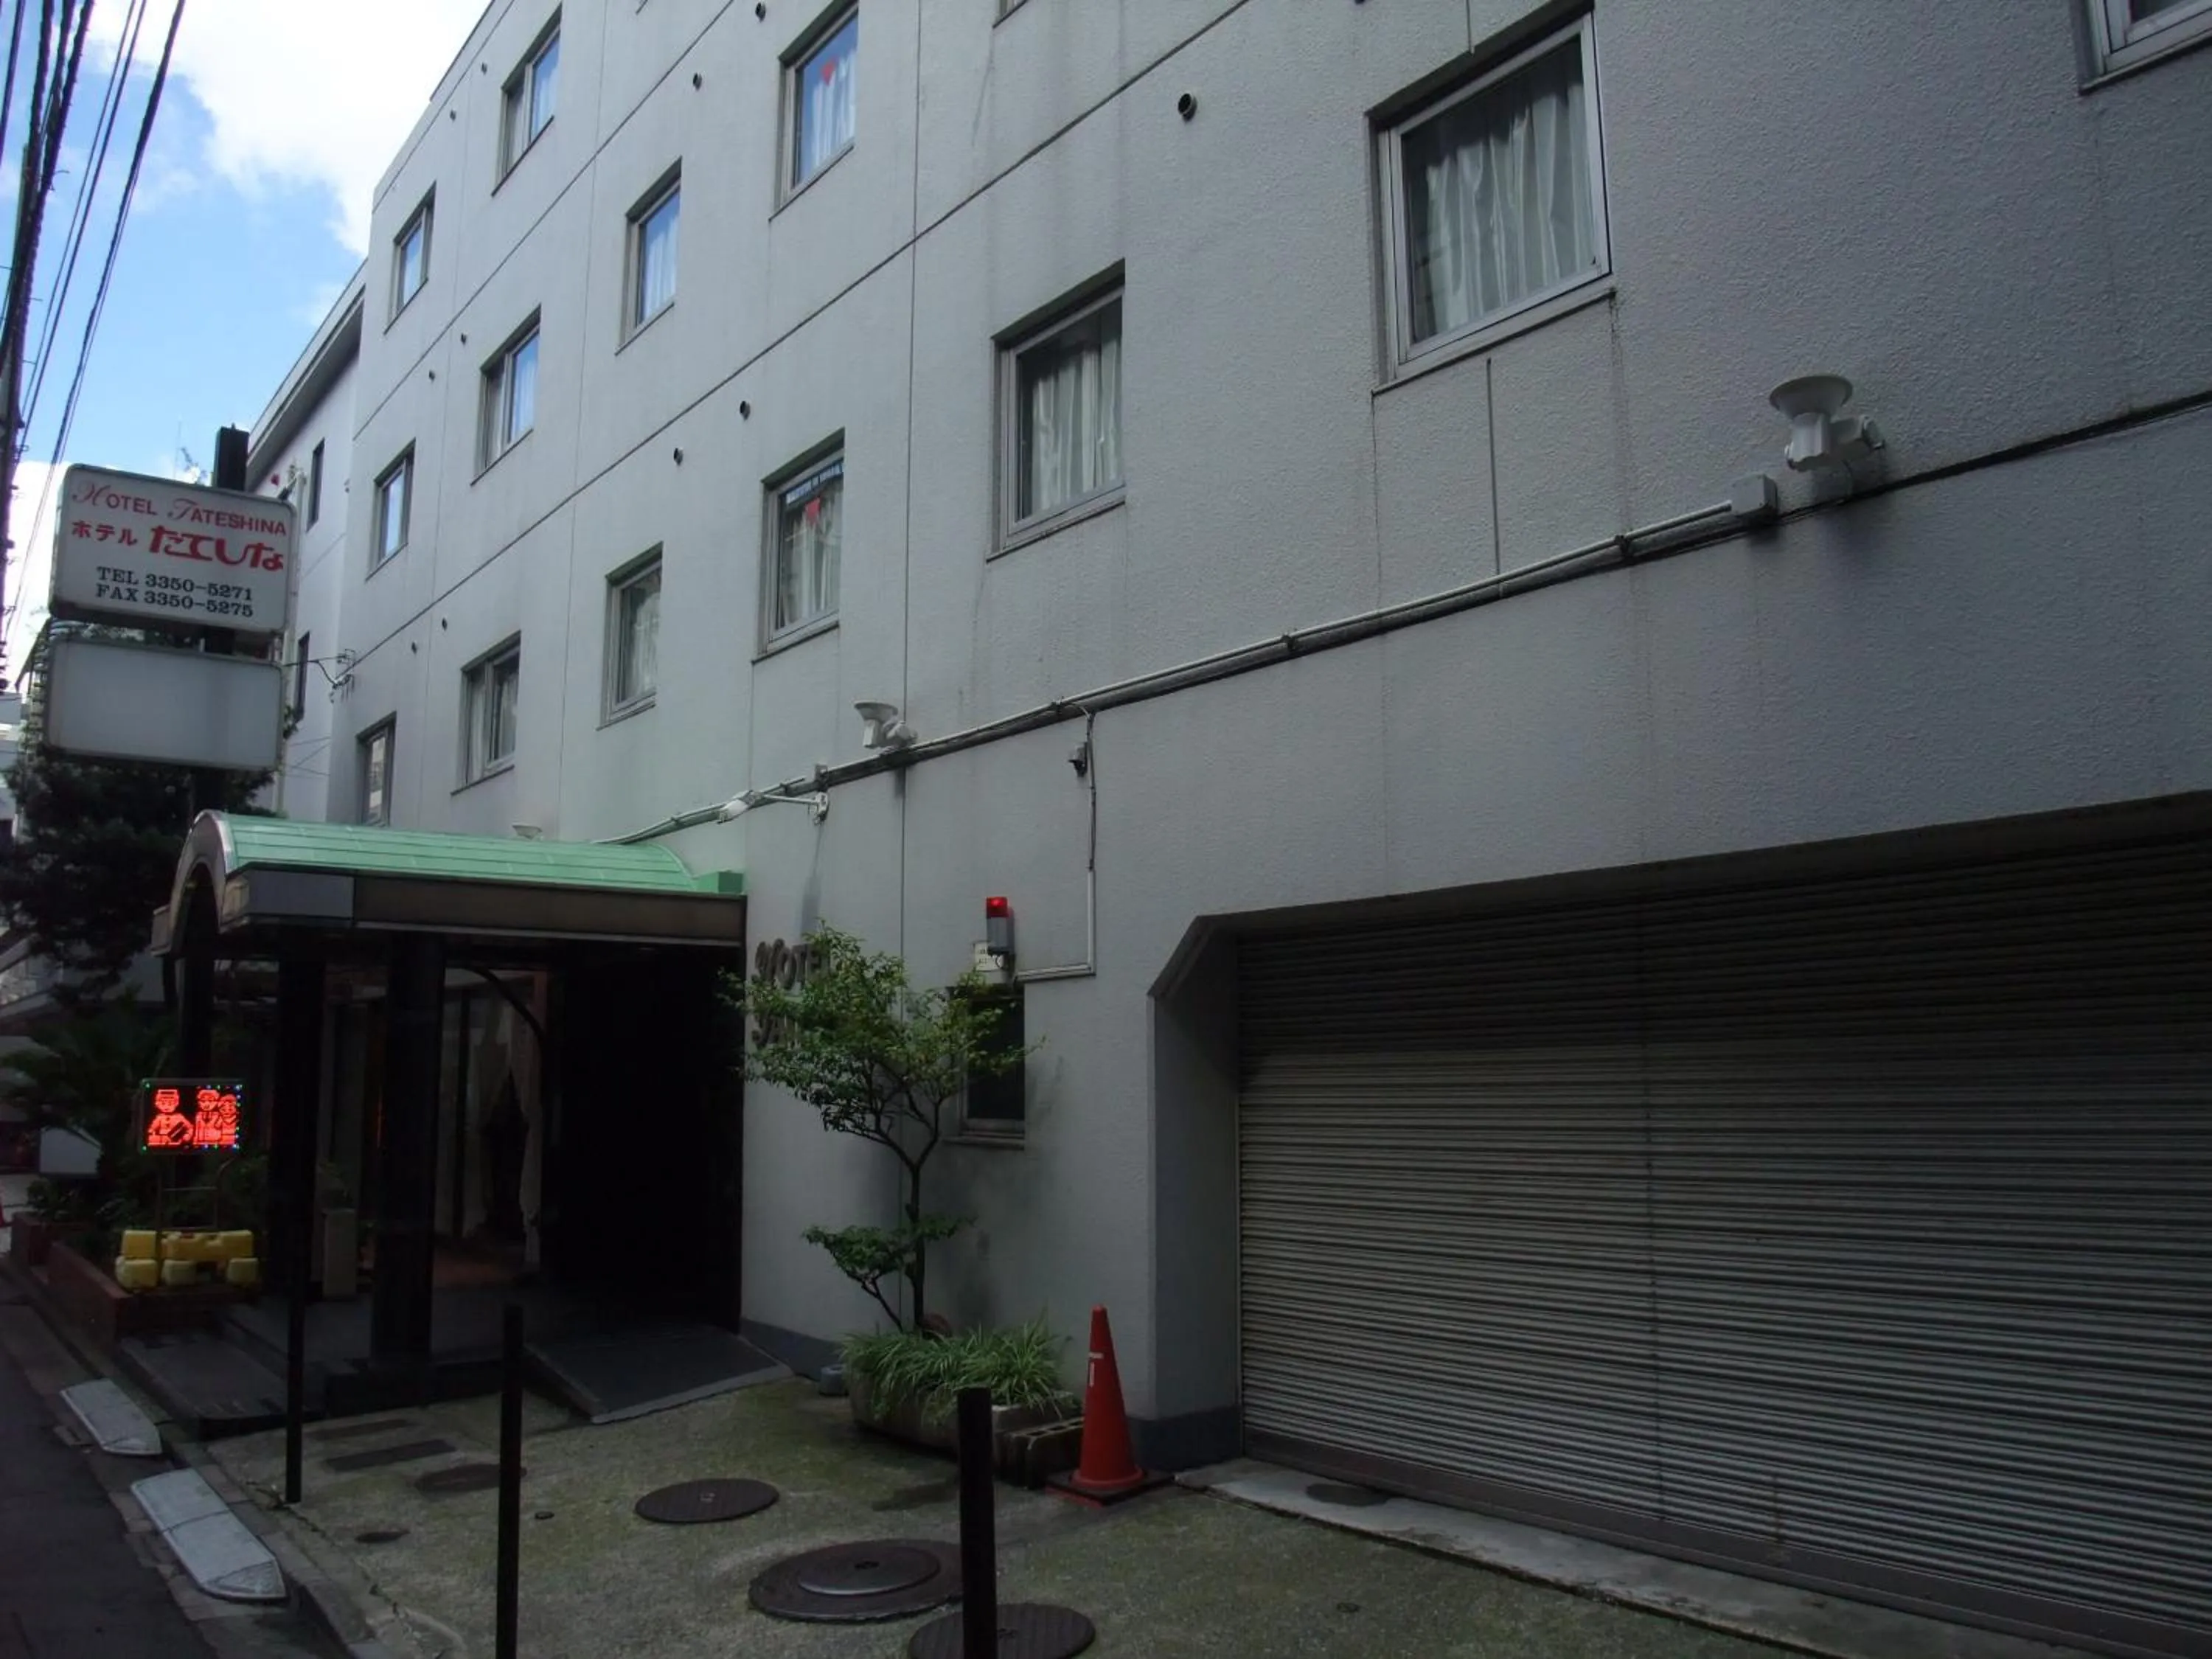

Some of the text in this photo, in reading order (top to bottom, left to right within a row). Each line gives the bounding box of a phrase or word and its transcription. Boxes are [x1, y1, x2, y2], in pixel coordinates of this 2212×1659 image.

[72, 481, 288, 536] HOTEL TATESHINA
[72, 520, 285, 571] ホテル たてしな
[95, 583, 254, 619] FAX 3350-5275
[96, 566, 253, 602] TEL 3350-5271
